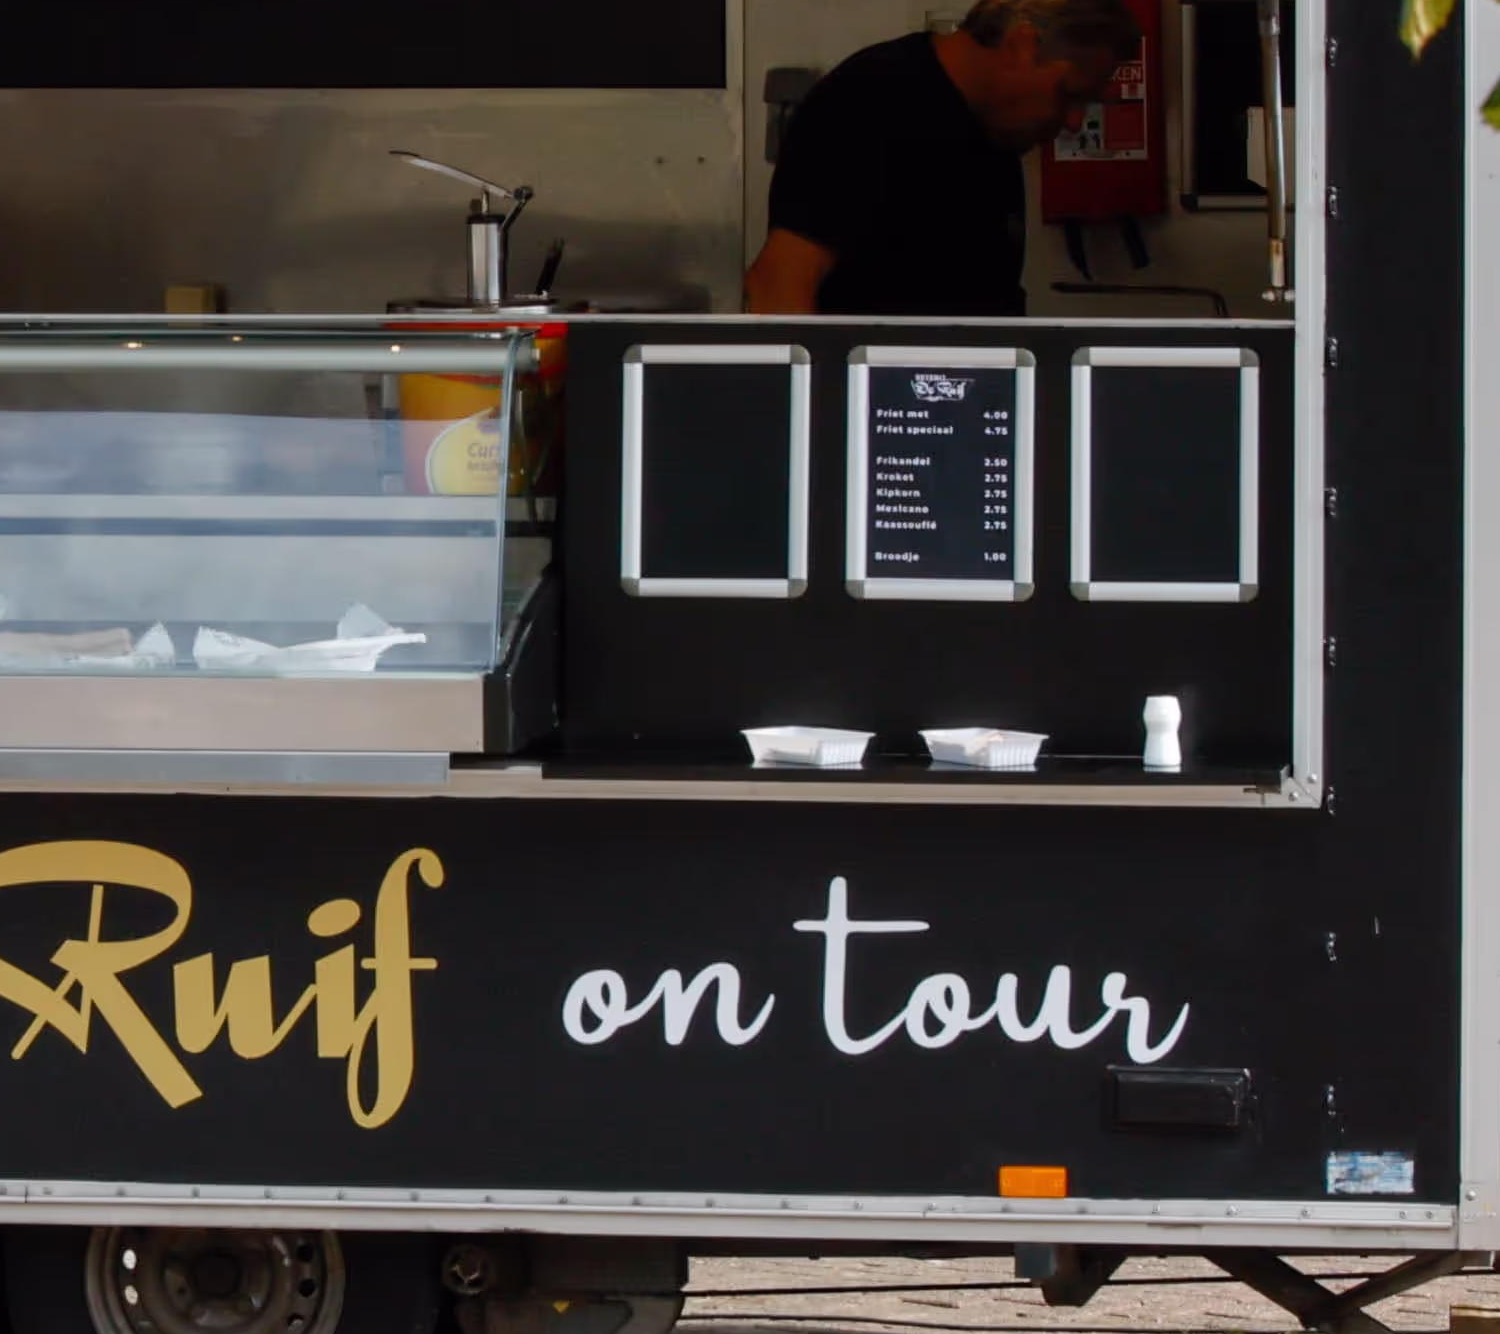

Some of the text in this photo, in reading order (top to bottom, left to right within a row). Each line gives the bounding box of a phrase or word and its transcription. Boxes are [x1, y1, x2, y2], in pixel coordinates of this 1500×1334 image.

[876, 408, 904, 419] Friet
[906, 410, 929, 419] met
[876, 424, 904, 434] Friet
[876, 456, 931, 466] Frikandel
[875, 504, 930, 514] Mexicano
[874, 551, 920, 563] Broodje
[561, 960, 777, 1047] on
[792, 874, 1191, 1065] tour
